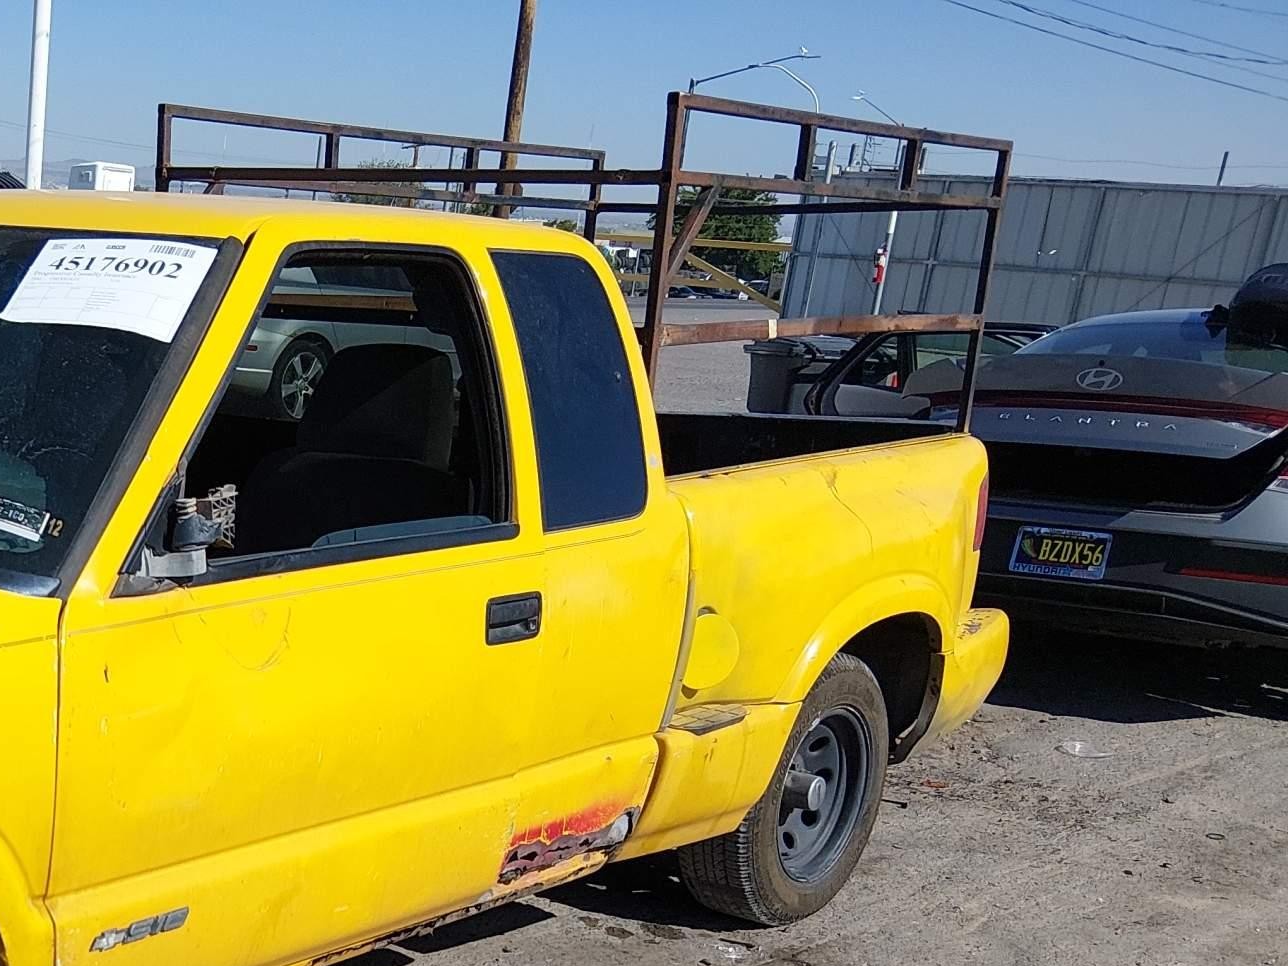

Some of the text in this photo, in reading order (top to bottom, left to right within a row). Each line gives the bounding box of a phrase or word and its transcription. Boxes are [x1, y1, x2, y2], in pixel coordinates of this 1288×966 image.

[48, 256, 183, 279] 45176902
[998, 412, 1178, 431] ELANTRA
[48, 519, 63, 536] 12
[1037, 538, 1105, 566] BZDX56
